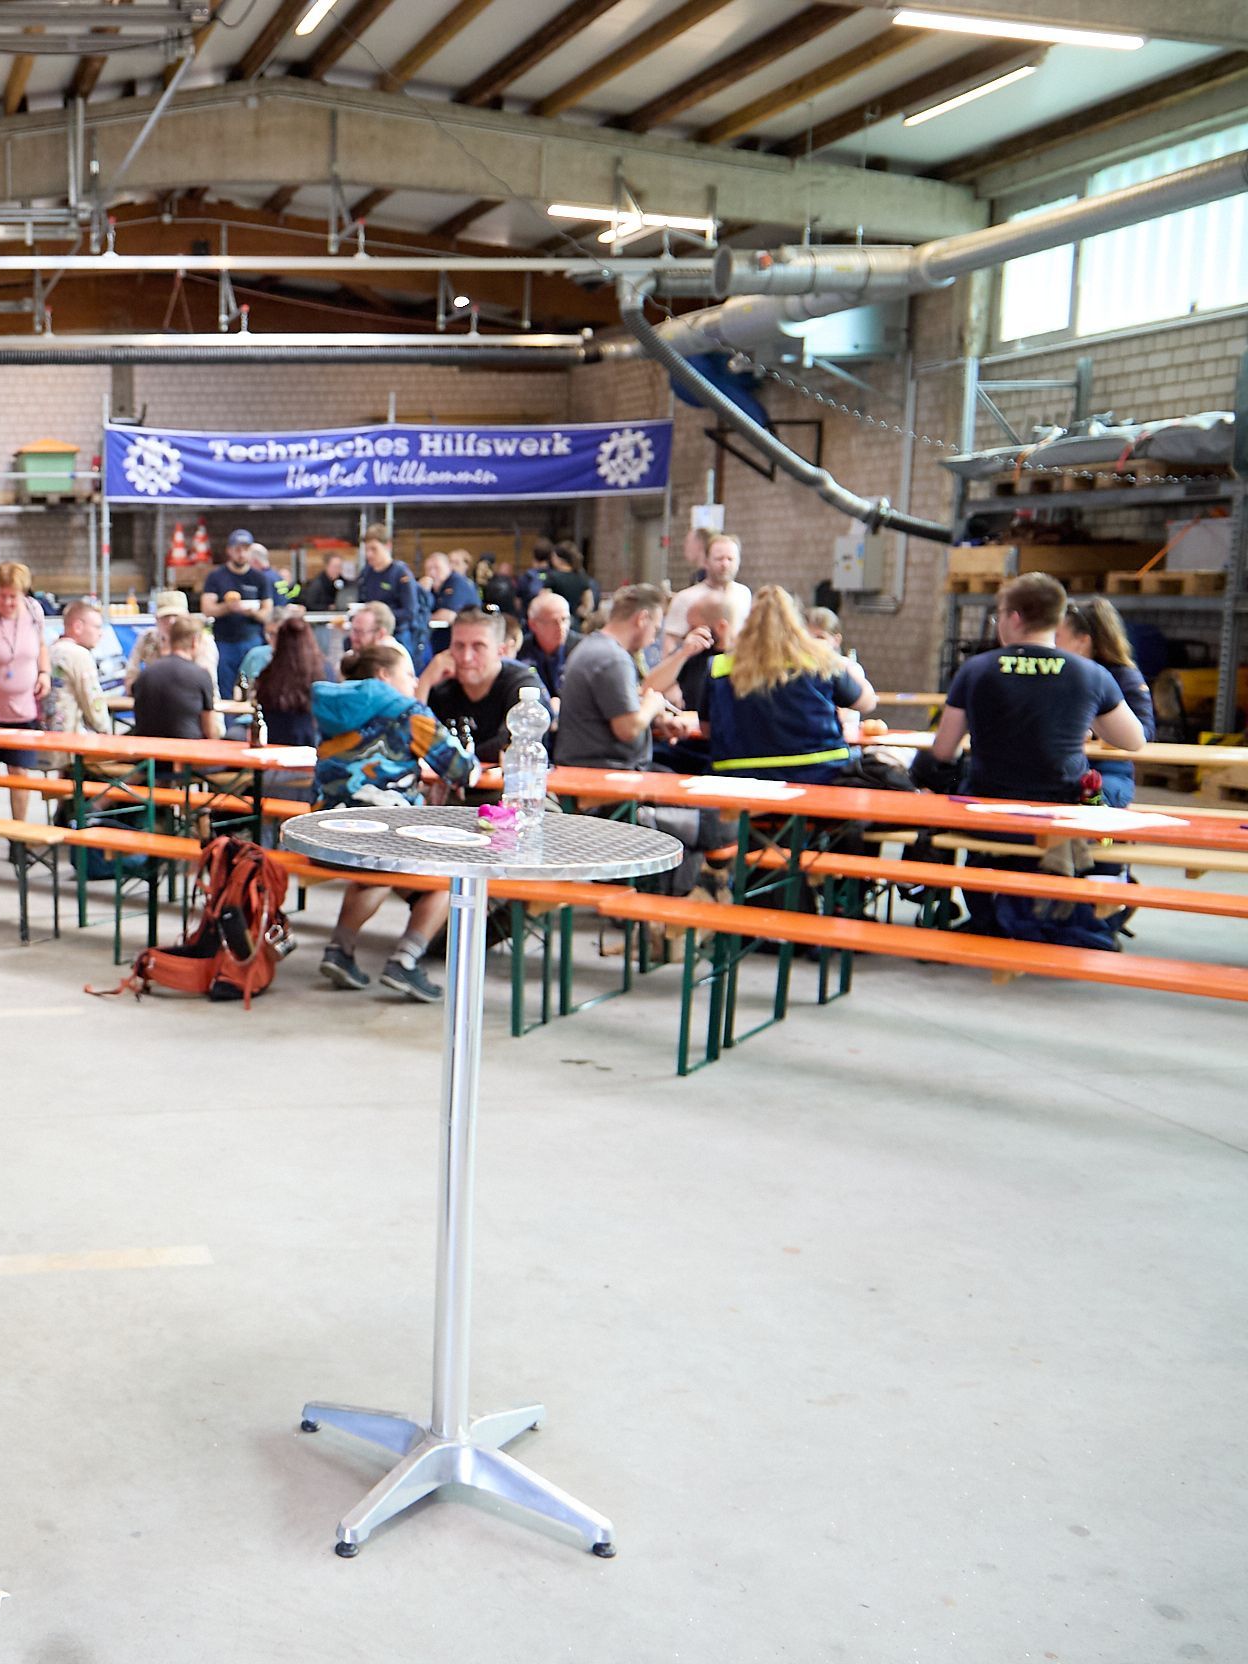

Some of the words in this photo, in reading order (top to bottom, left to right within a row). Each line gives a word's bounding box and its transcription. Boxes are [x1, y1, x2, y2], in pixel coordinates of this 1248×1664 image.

[208, 434, 410, 463] Technisches
[418, 432, 573, 457] Hilfswerk
[285, 461, 369, 497] Herzlich
[372, 459, 499, 486] Willkommen
[998, 655, 1066, 675] THW
